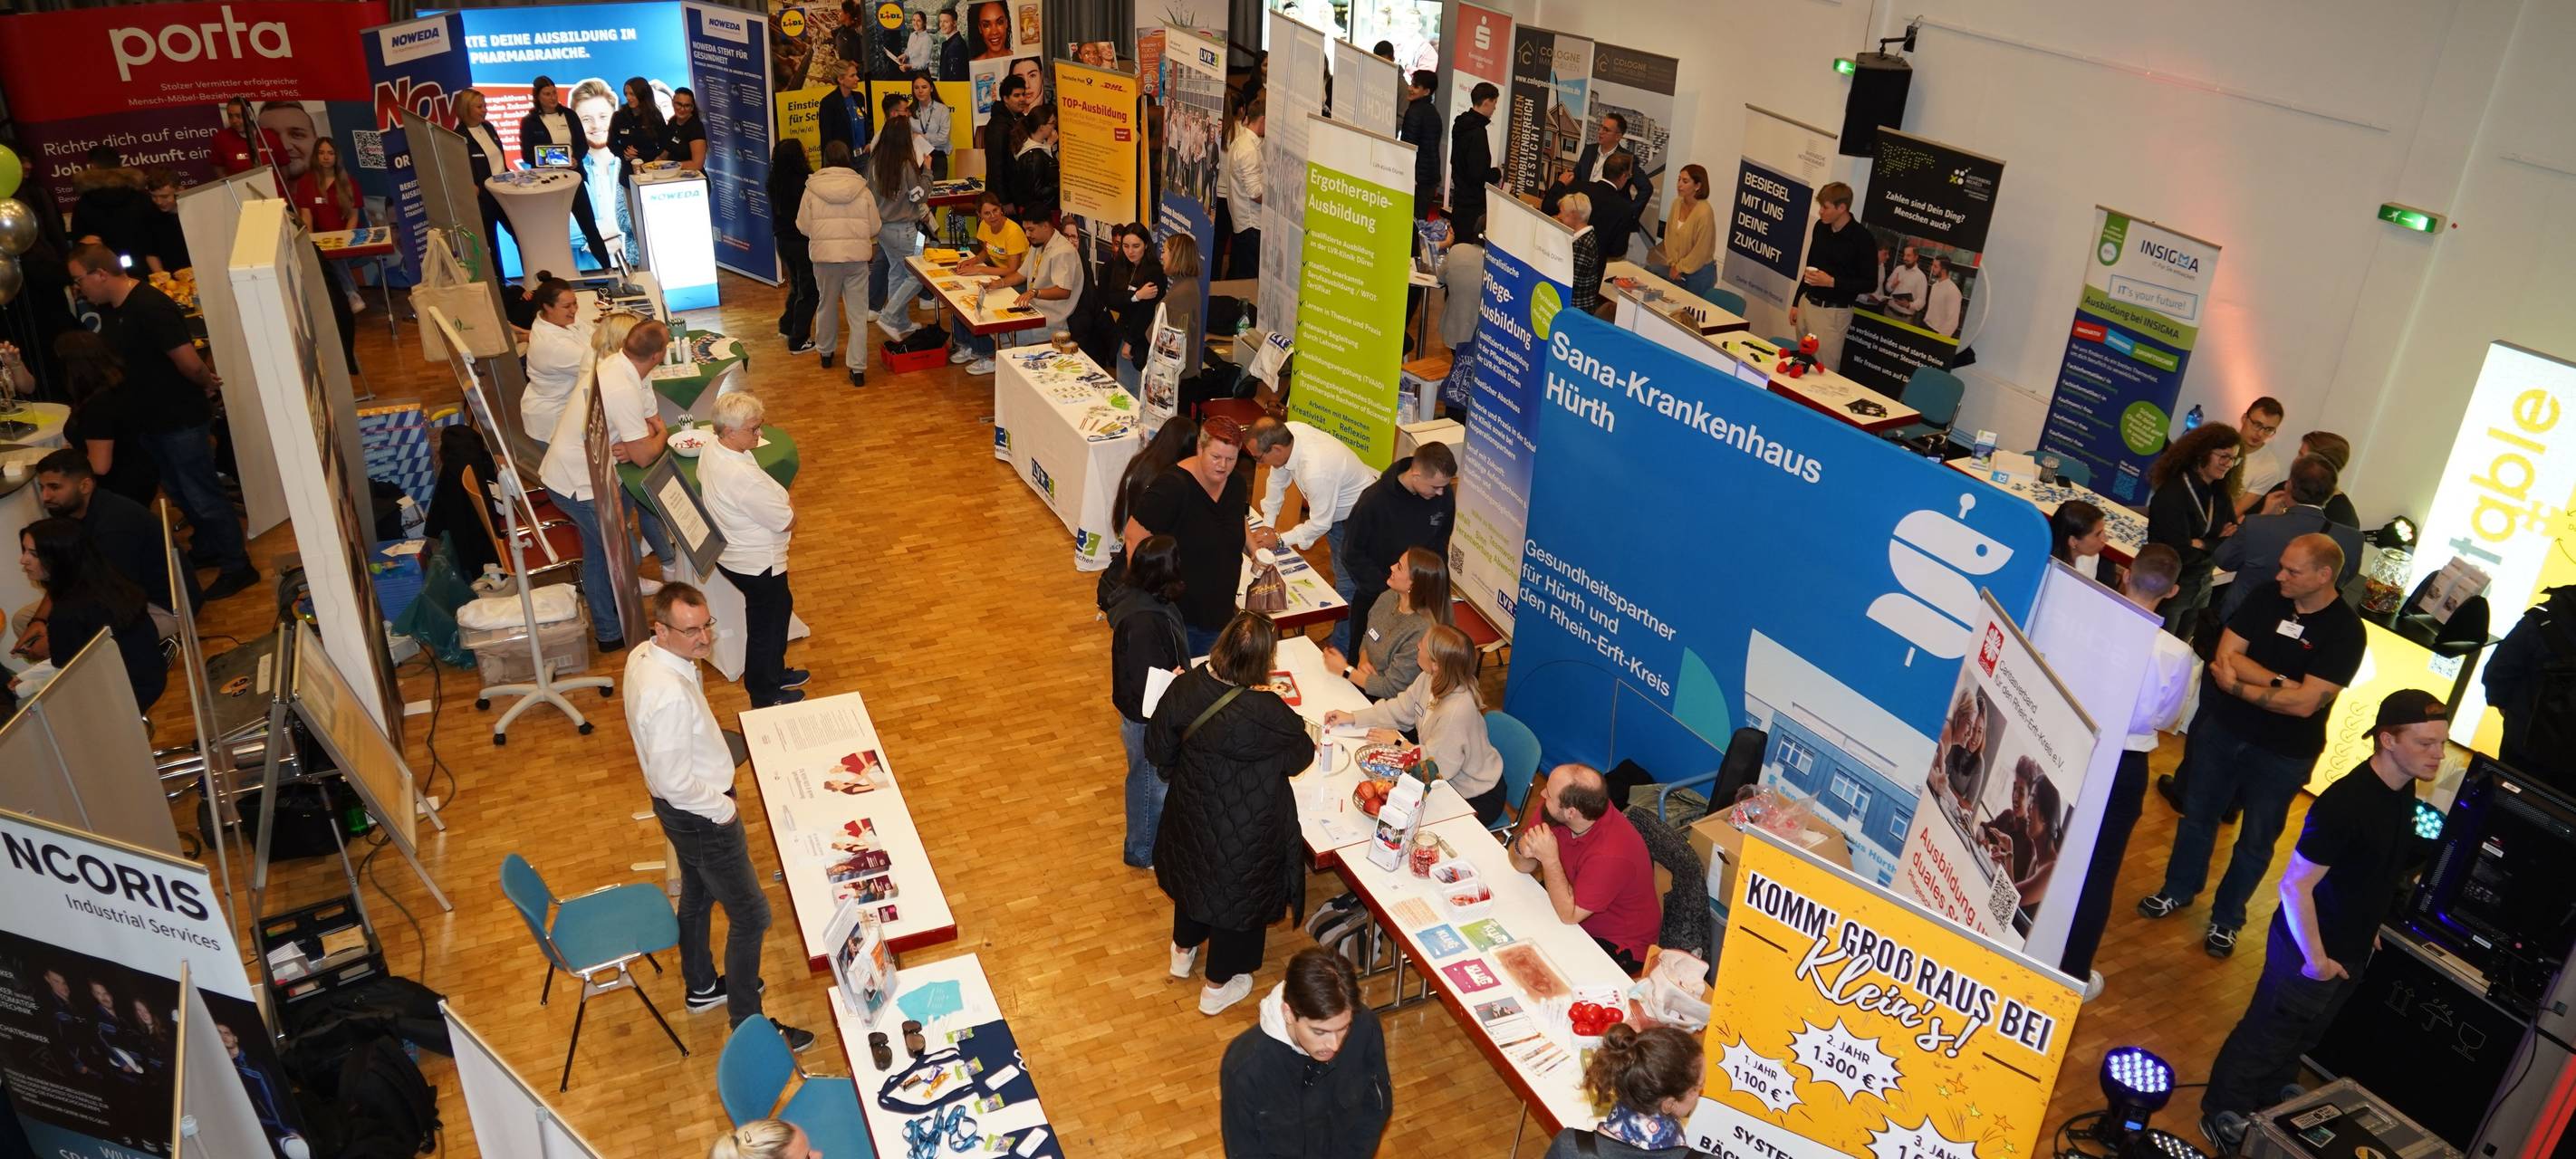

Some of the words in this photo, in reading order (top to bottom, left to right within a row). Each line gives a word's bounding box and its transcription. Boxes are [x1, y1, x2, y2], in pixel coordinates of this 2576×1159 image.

[391, 27, 439, 47] NOWEDA
[490, 33, 531, 46] DEINE
[534, 28, 617, 45] AUSBILDUNG
[620, 28, 636, 41] IN
[708, 18, 741, 31] NOWEDA
[109, 5, 293, 82] porta
[471, 46, 591, 64] PHARMABRANCHE.
[692, 41, 716, 53] NOWEDA
[717, 45, 735, 57] STEHT
[735, 49, 748, 60] FÜR
[693, 50, 728, 64] GESUNDHEIT
[1200, 49, 1215, 65] LVR
[1540, 46, 1581, 62] COLOGNE
[1613, 57, 1648, 71] COLOGNE
[160, 81, 193, 91] Stolzer
[195, 78, 242, 89] Vermittler
[243, 76, 298, 88] erfolgreicher
[260, 90, 278, 98] Seit
[279, 89, 301, 97] 1965.
[1103, 82, 1123, 92] DHL
[789, 114, 804, 125] für
[1062, 97, 1128, 123] TOP-Ausbildung
[43, 140, 97, 157] Richte
[102, 131, 137, 148] dich
[141, 128, 170, 143] auf
[174, 126, 218, 139] einen
[789, 126, 814, 135] (m/w/d)
[120, 148, 185, 167] Zukunft
[1516, 99, 1534, 196] IMMOBILIENBEREICH
[51, 162, 82, 178] Job
[650, 189, 700, 201] NOWEDA
[1311, 168, 1393, 208] Ergotherapie-
[1745, 171, 1790, 202] BESIEGEL
[1309, 194, 1376, 233] Ausbildung
[1741, 191, 1761, 210] MIT
[1762, 200, 1784, 221] UNS
[1886, 190, 1909, 206] Zahlen
[1910, 199, 1926, 210] sind
[1927, 204, 1944, 216] Dein
[1945, 210, 1966, 224] Ding?
[1894, 206, 1928, 225] Menschen
[1930, 220, 1951, 231] auch?
[1738, 212, 1768, 235] DEINE
[1311, 231, 1342, 247] qualifizierte
[1342, 240, 1375, 258] Ausbildung
[1317, 243, 1327, 251] der
[1328, 245, 1355, 263] LVR-Klinik
[1357, 254, 1374, 268] Düren
[1735, 232, 1782, 263] ZUKUNFT
[2140, 240, 2198, 273] INSIGMA
[1308, 261, 1331, 274] staatlich
[1332, 265, 1364, 286] anerkannte
[1485, 249, 1520, 278] Generalistische
[1306, 281, 1331, 296] Zertifikat
[1307, 271, 1355, 295] Berufsausbildung
[1483, 269, 1514, 303] Pflege-
[2135, 290, 2154, 303] your
[2157, 294, 2186, 310] future!
[1305, 301, 1323, 314] Lernen
[1324, 308, 1330, 316] in
[1331, 310, 1351, 325] Theorie
[1353, 320, 1364, 330] und
[1365, 322, 1381, 337] Praxis
[1479, 298, 1532, 350] Ausbildung
[2085, 295, 2130, 321] Ausbildung
[2130, 311, 2142, 324] bei
[2143, 319, 2179, 340] INSIGMA
[1303, 331, 1318, 343] durch
[1319, 336, 1346, 352] Lehrende
[1304, 321, 1328, 335] Intensive
[1328, 329, 1359, 350] Begleitung
[1856, 326, 1879, 341] verbinde
[1880, 336, 1898, 348] beides
[1898, 344, 1910, 353] und
[1910, 349, 1927, 359] starte
[1927, 354, 1944, 367] Deine
[1479, 330, 1504, 352] qualifizierte
[1505, 347, 1529, 371] Ausbildung
[1489, 348, 1520, 375] Pflegeschule
[1879, 346, 1899, 359] unserer
[1301, 350, 1362, 382] Ausbildungsvergütung
[1483, 357, 1507, 381] LVR-Klinik
[1507, 374, 1522, 389] Düren
[1854, 354, 1863, 364] Wir
[1864, 359, 1881, 371] freuen
[1882, 366, 1892, 376] uns
[1892, 372, 1902, 380] auf
[1299, 380, 1334, 401] (Ergotherapie
[1335, 394, 1360, 409] Bachelor
[1366, 407, 1390, 425] Science)
[1300, 369, 1369, 405] Ausbildungsbegleitendes
[1368, 398, 1391, 414] Studium
[1474, 377, 1496, 398] staatlicher
[1497, 390, 1521, 414] Abschluss
[1545, 372, 1615, 433] Hürth
[1292, 403, 1326, 425] Kreativität
[1308, 399, 1331, 414] Arbeiten
[1332, 410, 1341, 418] mit
[1342, 414, 1370, 432] Menschen
[1473, 398, 1487, 417] Theorie
[1488, 408, 1496, 422] und
[1497, 414, 1512, 432] Praxis
[1551, 331, 1822, 484] Sana-Krankenhaus
[1331, 428, 1370, 453] Teamarbeit
[1339, 423, 1370, 443] Reflexion
[1469, 420, 1516, 461] Kooperationspartnern
[1478, 417, 1492, 433] Klinik
[1492, 426, 1506, 441] sowie
[1499, 594, 1514, 613] LVR
[1522, 563, 1542, 585] für
[1545, 575, 1585, 614] Hürth
[1590, 607, 1619, 635] und
[1525, 539, 1676, 641] Gesundheitspartner
[1520, 587, 1545, 614] den
[1550, 604, 1669, 696] Rhein-Erft-Kreis
[2000, 660, 2038, 714] Caritasverband
[2002, 685, 2013, 703] den
[2013, 696, 2053, 757] Rhein-Erft-Kreis
[2052, 753, 2064, 773] e.V.
[0, 830, 210, 922] NCORIS
[1913, 851, 1946, 910] duales
[1920, 827, 1976, 927] Ausbildung
[65, 893, 146, 931] Industrial
[149, 918, 222, 953] Services
[1746, 874, 1836, 938] KOMM'
[1842, 922, 1915, 982] GROß
[1918, 957, 1995, 1023] RAUS
[2000, 1000, 2053, 1055] BEI
[1796, 935, 1984, 1058] Klein's!
[1812, 1044, 1857, 1080] 1.300
[1827, 1033, 1839, 1049] 2.
[1839, 1040, 1870, 1066] JAHR
[1733, 1065, 1766, 1094] 1.100
[1753, 1058, 1778, 1080] JAHR
[1914, 1135, 1924, 1150] 3.
